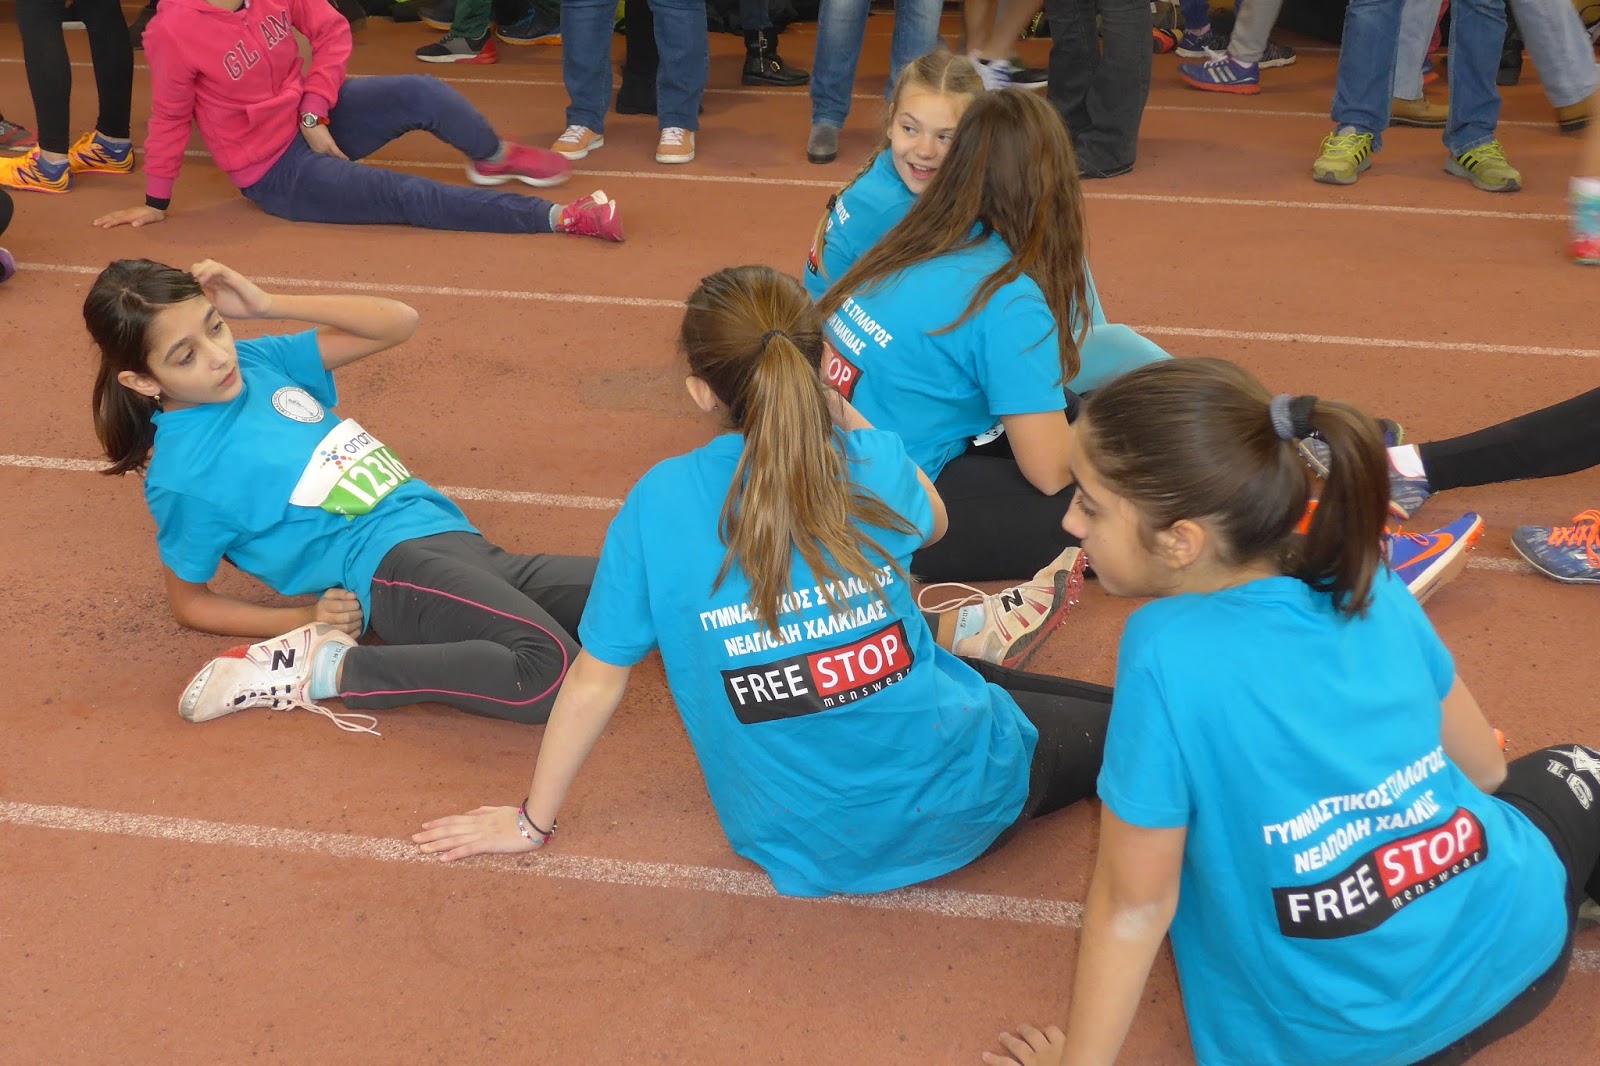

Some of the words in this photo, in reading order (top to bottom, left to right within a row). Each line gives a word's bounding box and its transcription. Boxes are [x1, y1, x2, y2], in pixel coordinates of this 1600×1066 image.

[848, 303, 893, 349] ΣΥΛΛΟΓΟΣ
[828, 357, 852, 386] OP
[337, 447, 411, 507] 12316
[1000, 588, 1024, 613] N
[270, 648, 296, 671] N
[729, 664, 809, 706] FREE
[816, 633, 899, 689] STOP
[823, 668, 911, 708] menswear
[1263, 783, 1393, 845] ΓΥΜΝΑΣΤΙΚΟΣ
[1287, 864, 1380, 923] FREE
[1382, 815, 1473, 887] STOP
[1294, 817, 1371, 874] ΝΕΑΠΟΛΗ
[1391, 851, 1481, 910] menswear
